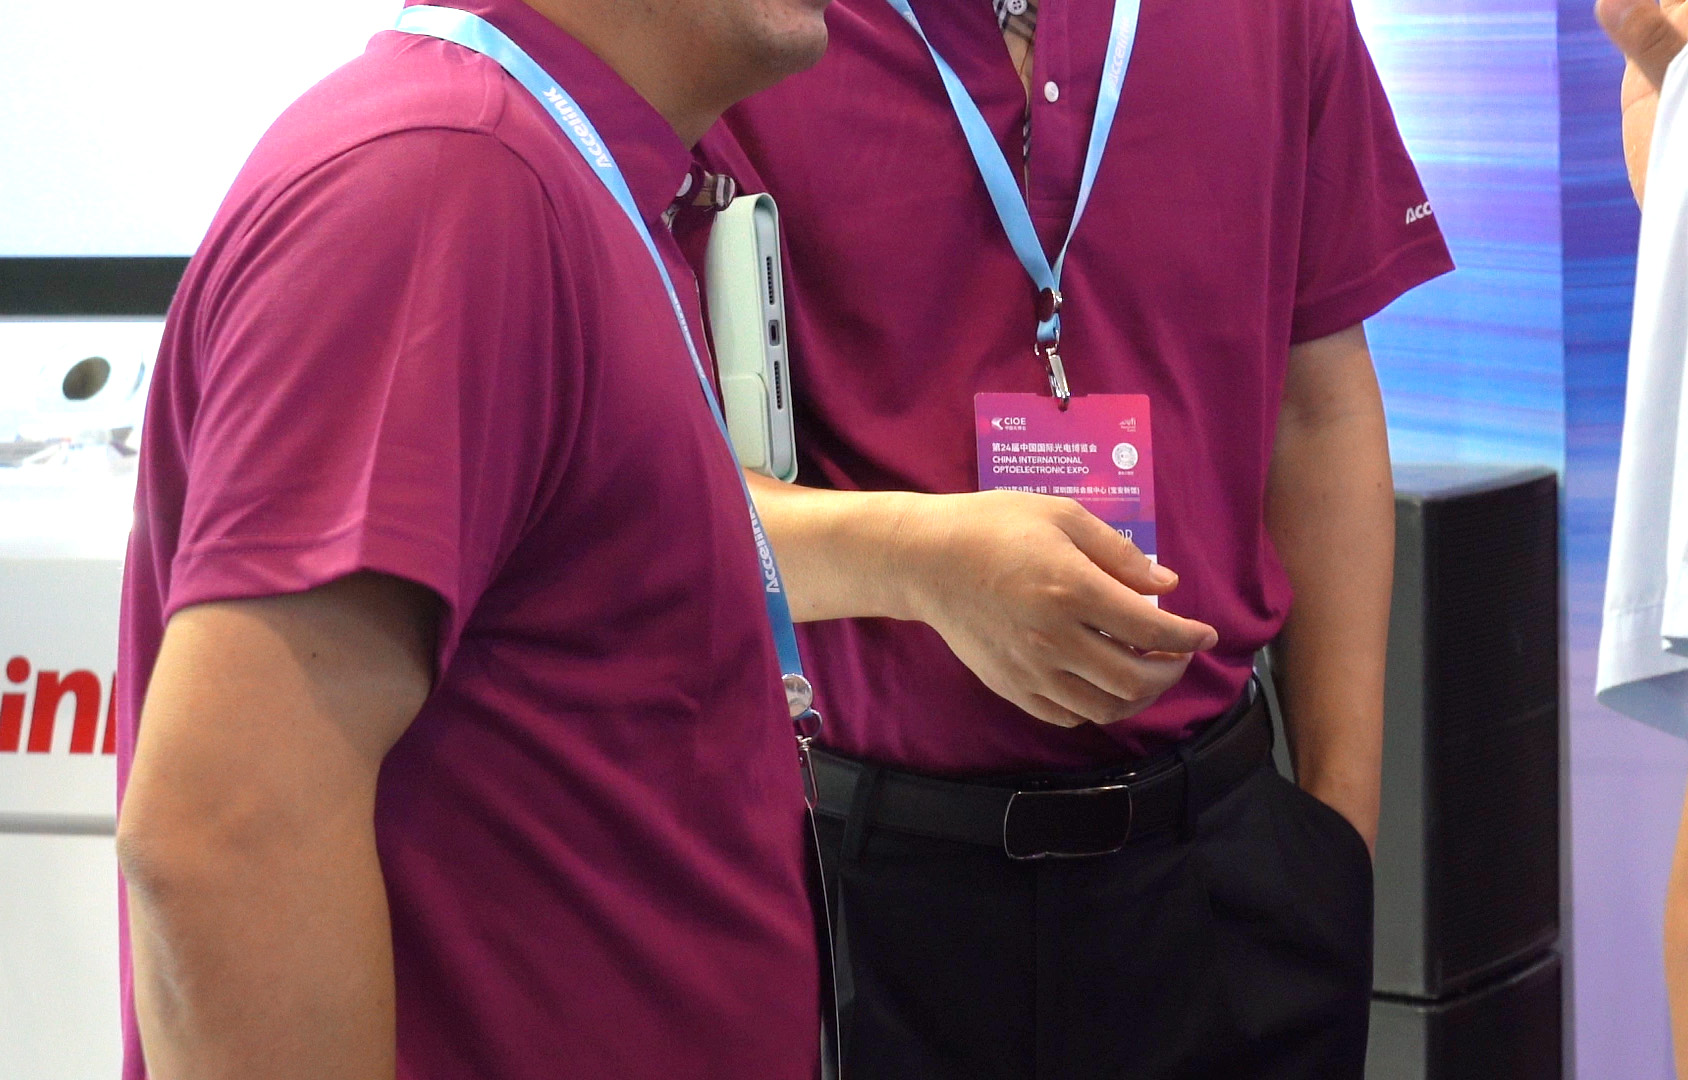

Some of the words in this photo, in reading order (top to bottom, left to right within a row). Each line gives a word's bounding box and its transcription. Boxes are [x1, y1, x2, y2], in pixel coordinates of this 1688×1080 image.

[541, 86, 613, 168] Accelink
[1004, 417, 1027, 426] CIOE
[992, 442, 1098, 453] 第24届中国国际光电博览会
[992, 455, 1017, 464] CHINA
[1018, 455, 1082, 464] INTERNATIONAL
[993, 465, 1065, 474] OPTOELECTRONIC
[1067, 465, 1090, 474] EXPO
[0, 656, 117, 755] in
